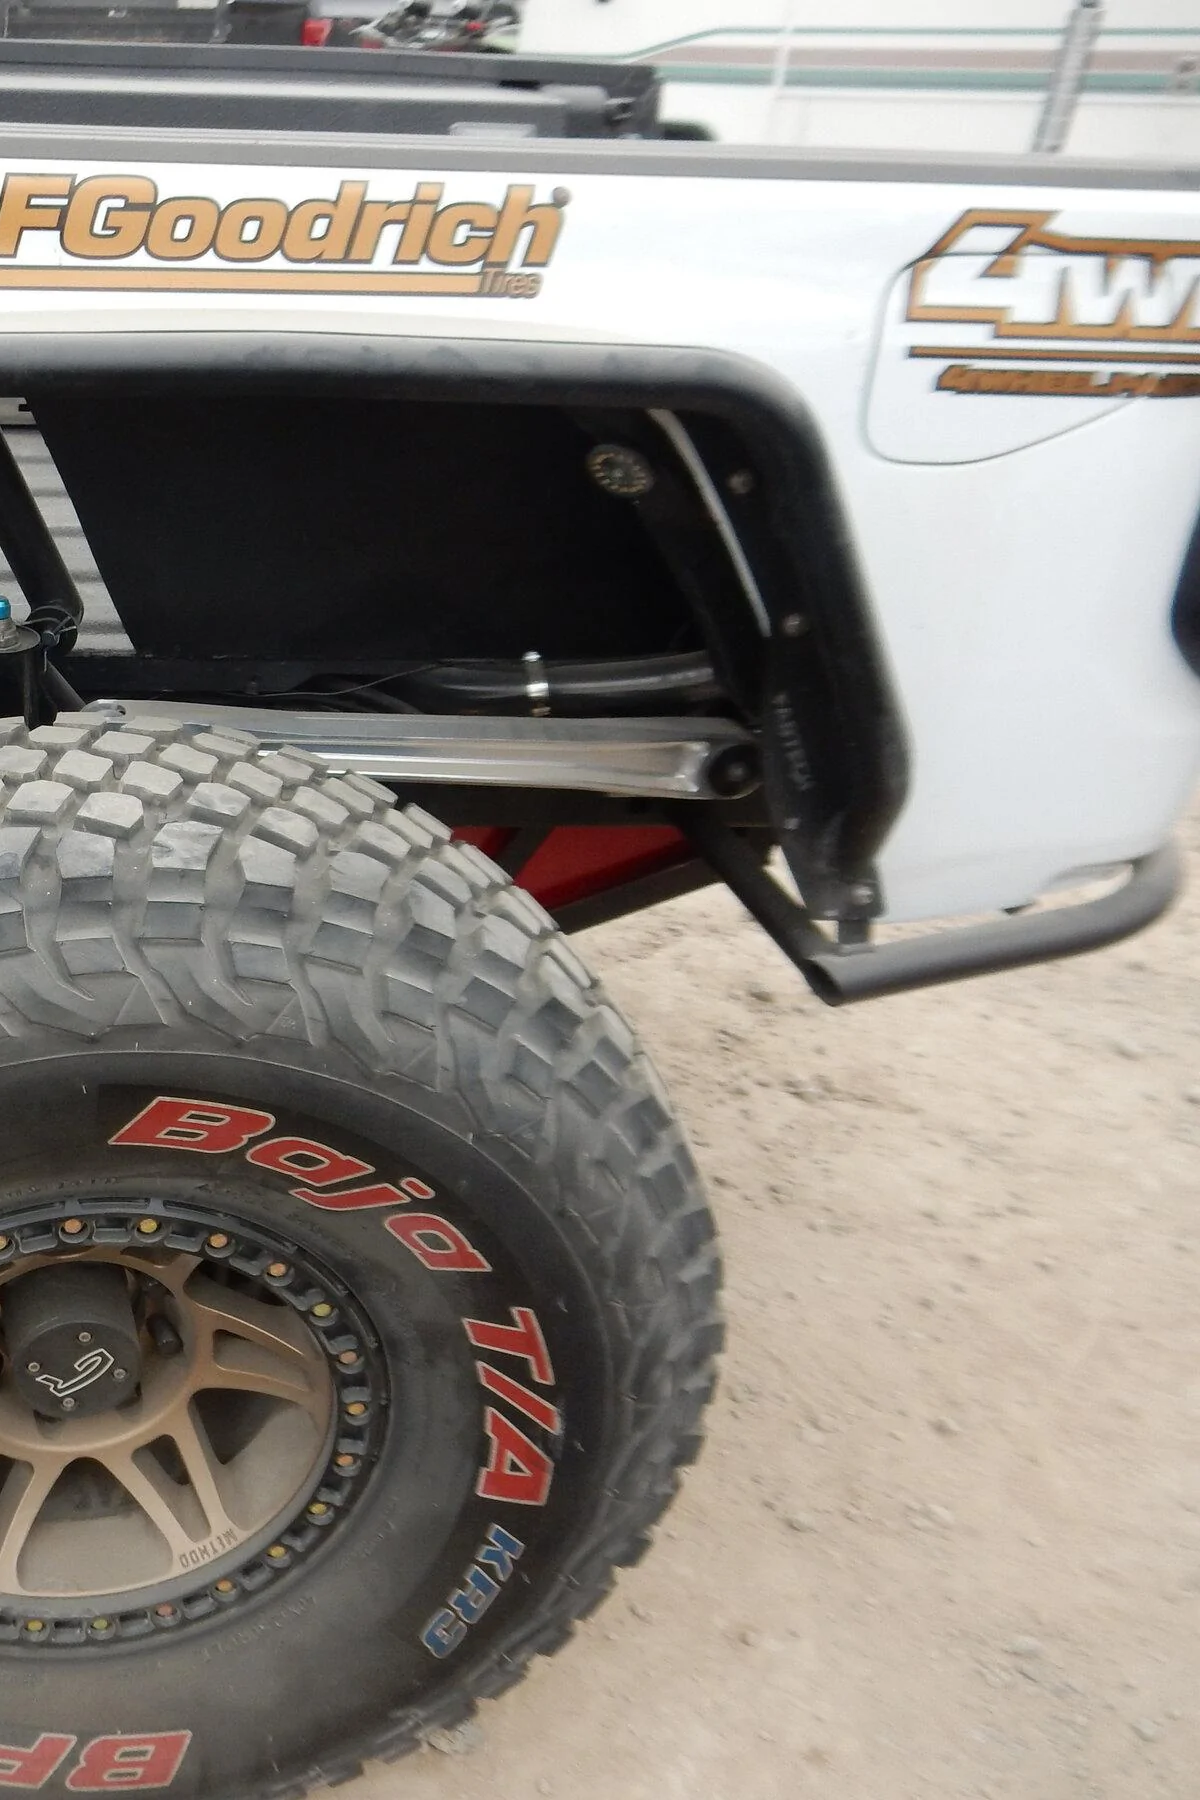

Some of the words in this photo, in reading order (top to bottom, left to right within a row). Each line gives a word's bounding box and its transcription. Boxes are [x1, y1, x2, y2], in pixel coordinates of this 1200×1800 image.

[905, 208, 1200, 342] 4W
[109, 1096, 493, 1272] Baja
[461, 1306, 565, 1506] T/A
[178, 1527, 240, 1570] METHOD
[421, 1522, 526, 1660] KR3
